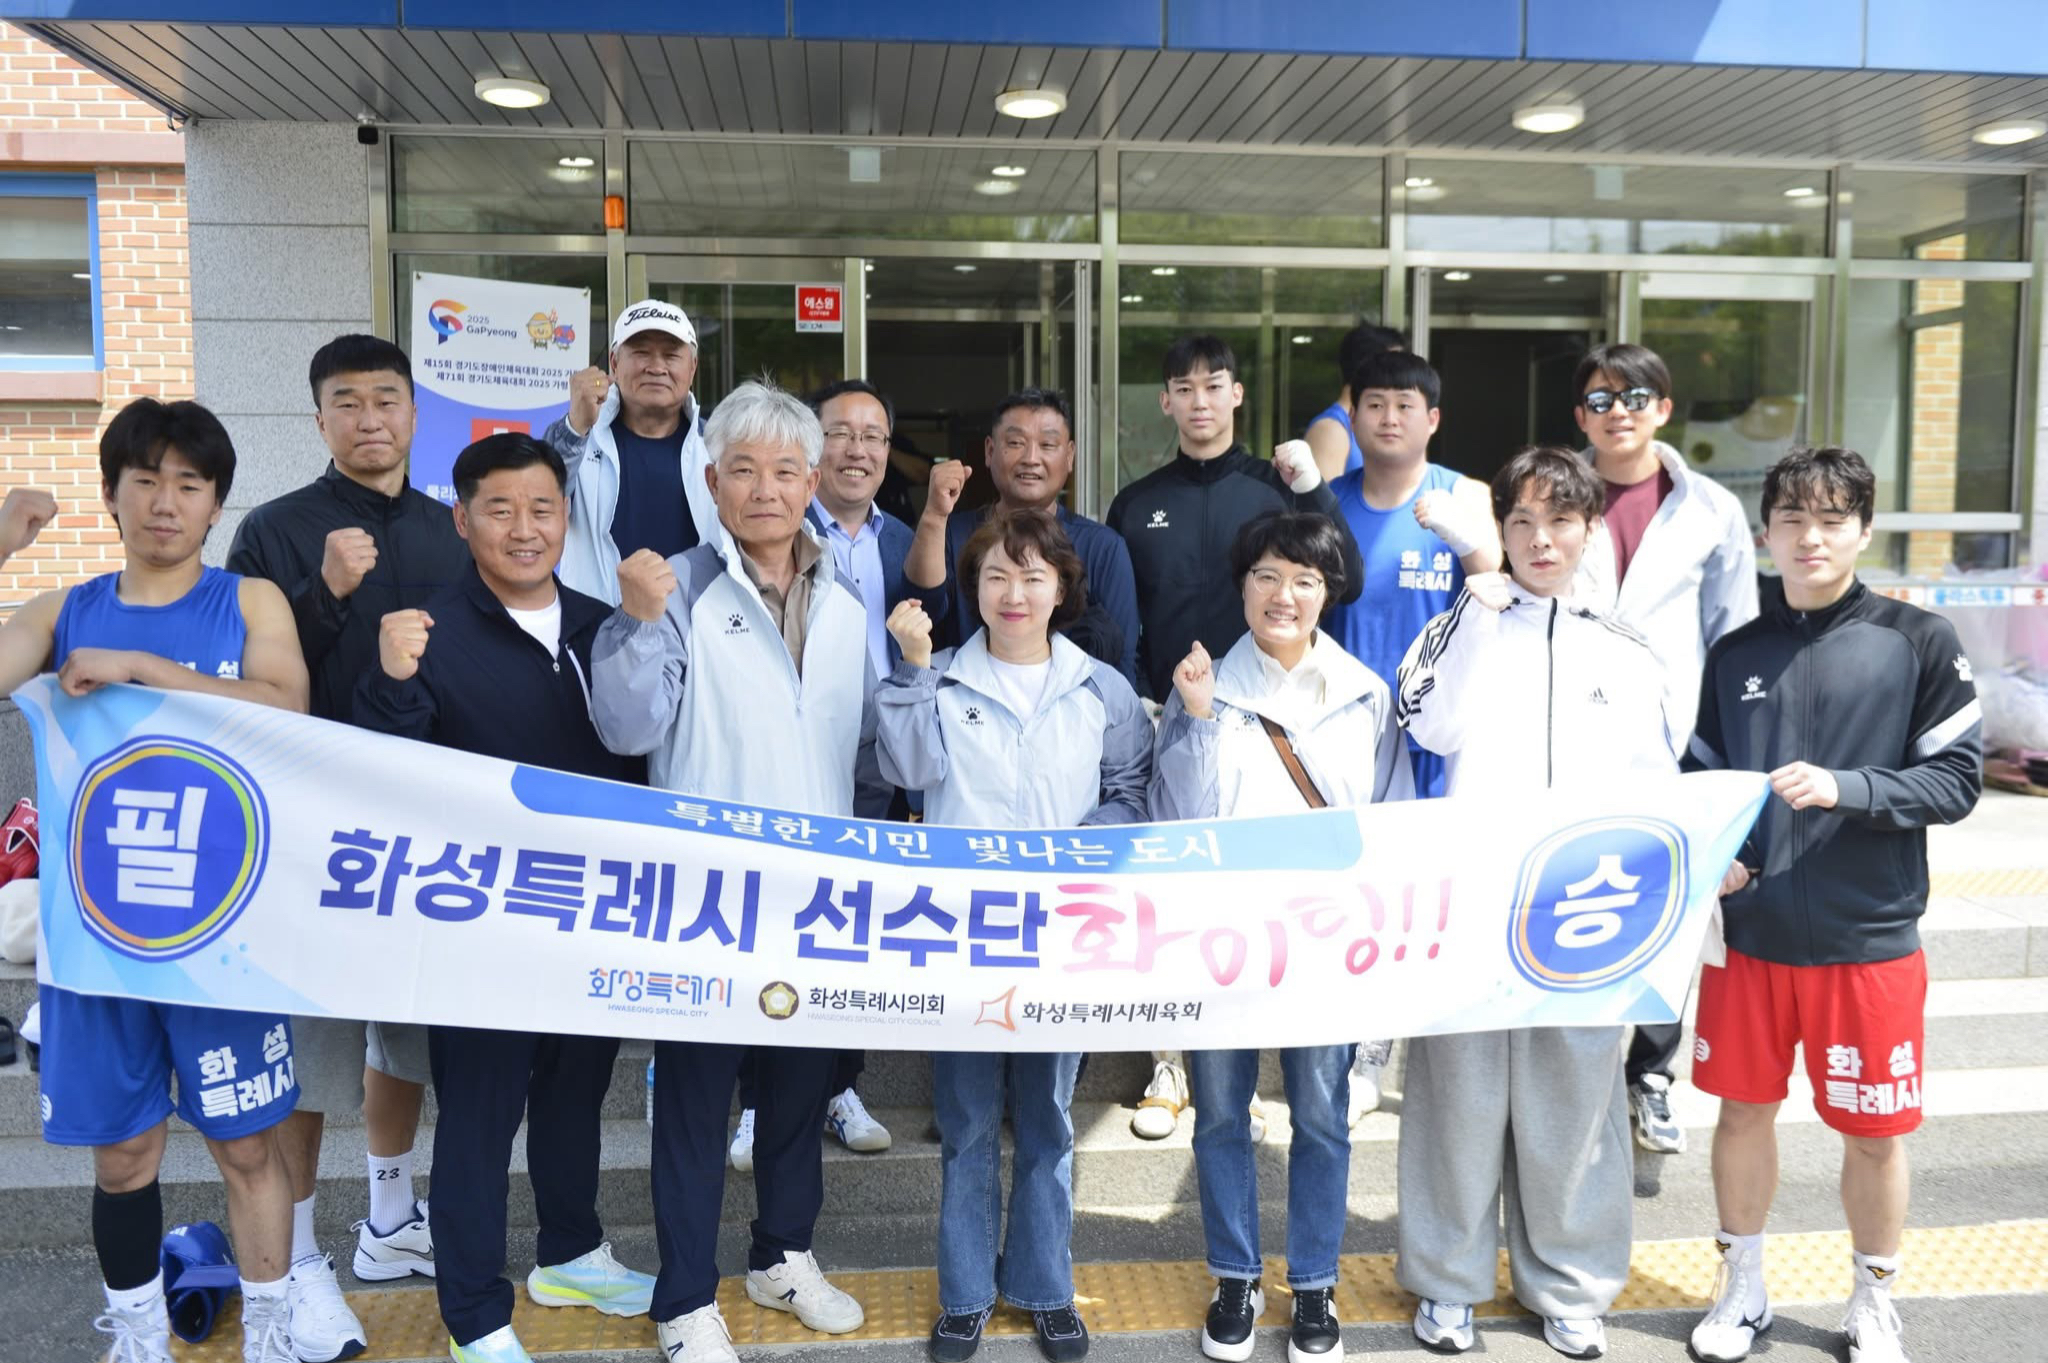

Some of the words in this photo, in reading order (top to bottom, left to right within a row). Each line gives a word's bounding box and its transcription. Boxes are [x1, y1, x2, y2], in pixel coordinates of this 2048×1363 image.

[467, 314, 490, 325] 2025
[624, 307, 681, 326] Titleist
[466, 325, 518, 339] GaPyeong
[424, 358, 452, 369] 제15회
[541, 367, 562, 377] 2025
[437, 371, 465, 382] 제71회
[469, 373, 527, 387] 경기도체육대회
[528, 379, 550, 389] 2025
[725, 627, 750, 635] KELME
[665, 800, 820, 845] 특별한
[835, 826, 932, 859] 시민
[966, 835, 1113, 866] 빛나는
[1129, 829, 1222, 866] 도시
[106, 786, 208, 908] 필
[319, 828, 761, 953] 화성특례시
[794, 876, 1048, 968] 선수단
[1553, 854, 1642, 949] 승
[587, 967, 733, 1008] 화성특례시
[608, 1003, 654, 1014] HWASEONG
[655, 1007, 689, 1017] SPECIAL
[690, 1009, 709, 1018] CITY
[808, 986, 945, 1015] 화성특례시의회
[888, 1017, 906, 1025] CITY
[1021, 1000, 1202, 1024] 화성특례시체육회
[199, 1056, 295, 1118] 특례시
[1825, 1076, 1923, 1115] 특례시
[376, 1167, 400, 1181] 23
